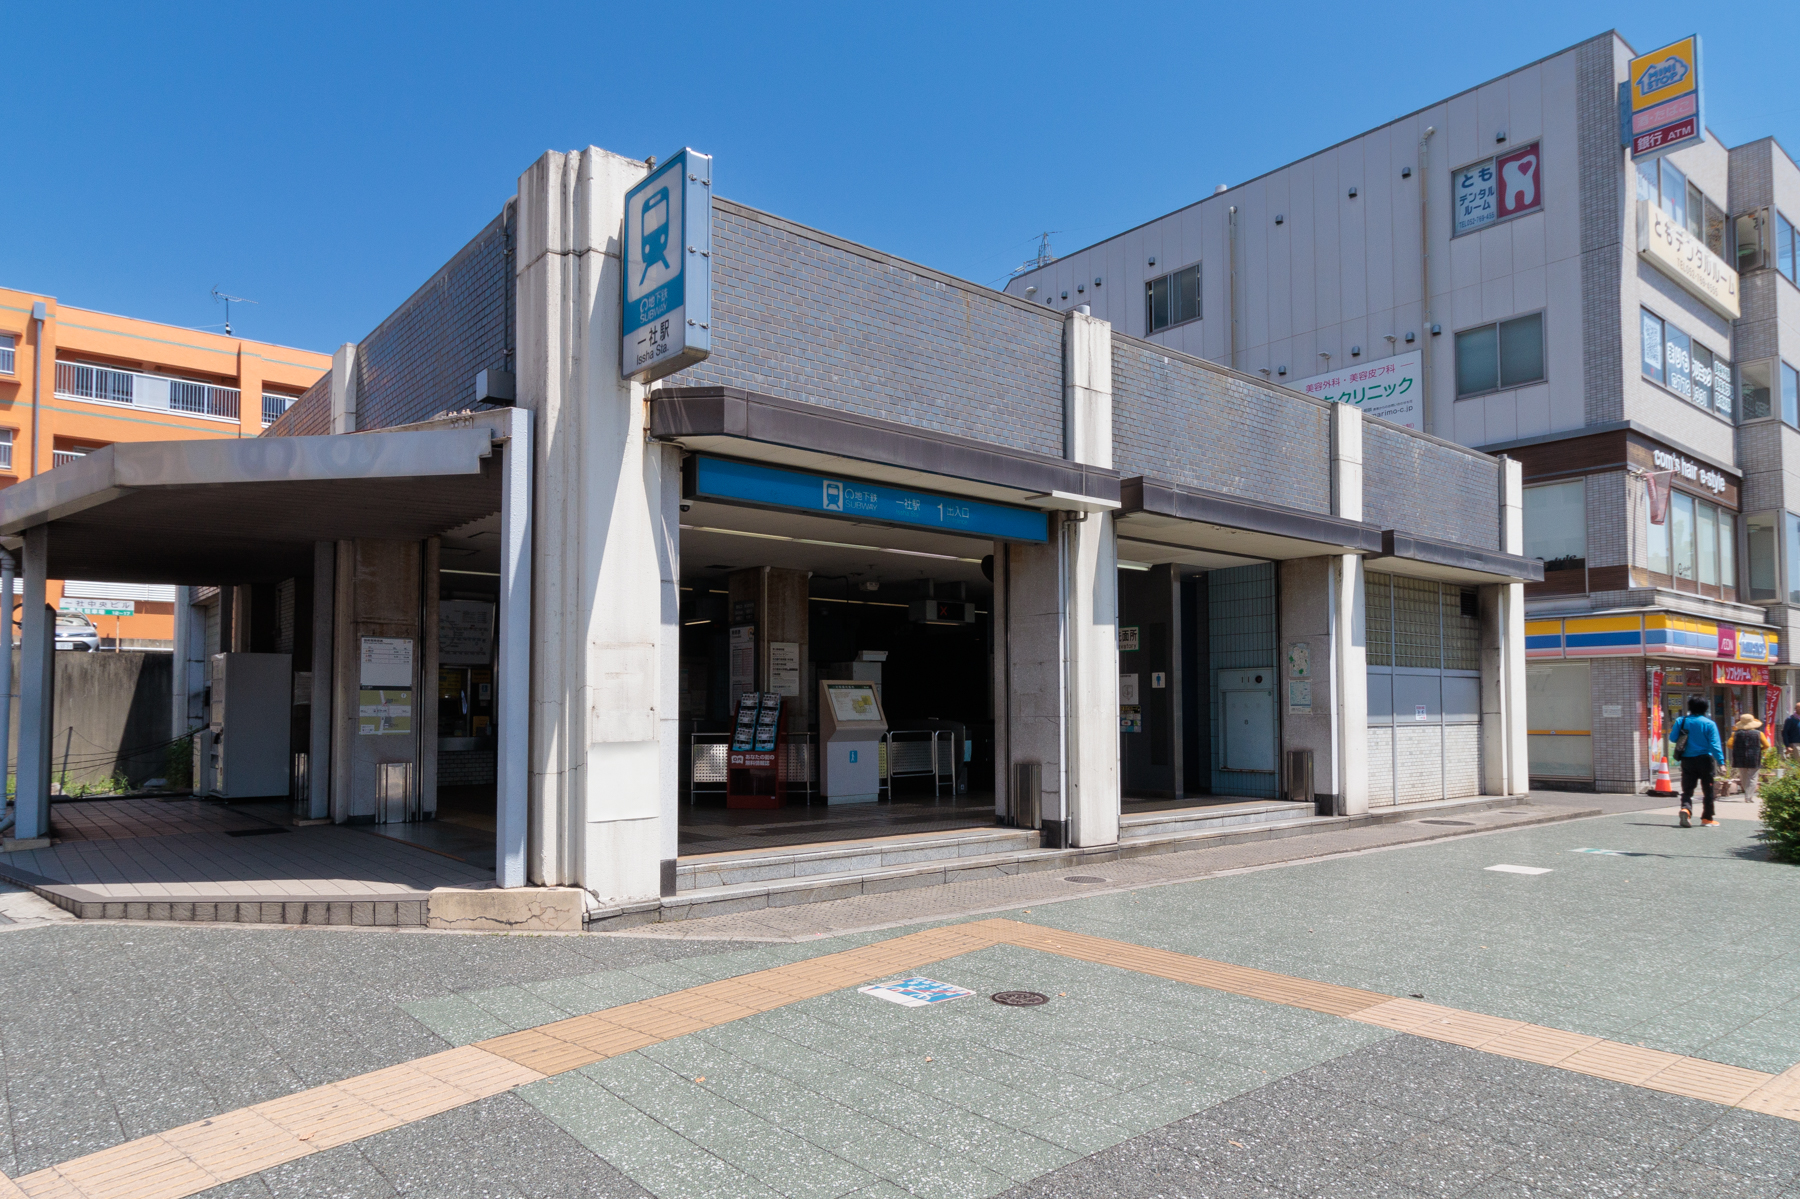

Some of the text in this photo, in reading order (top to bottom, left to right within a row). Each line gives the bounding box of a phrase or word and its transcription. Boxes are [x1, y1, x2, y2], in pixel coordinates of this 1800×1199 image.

[1647, 71, 1678, 90] STOP
[1648, 63, 1676, 80] MINI
[1637, 125, 1692, 151] 銀行 ATM
[1461, 167, 1493, 188] とも
[1459, 185, 1495, 206] デンタル
[1463, 201, 1491, 216] ルーム
[1654, 213, 1736, 298] ともデンタルルーム
[648, 288, 669, 306] 地下鉄
[640, 302, 668, 324] SUBWAY
[637, 318, 670, 346] 一社駅
[636, 350, 654, 366] Issha
[1653, 449, 1726, 494] com's hair e-style
[845, 501, 878, 511] SUBWAY
[855, 491, 970, 522] 地下鉄 一社駅 1 出入口
[64, 600, 130, 609] 一社中央ビル
